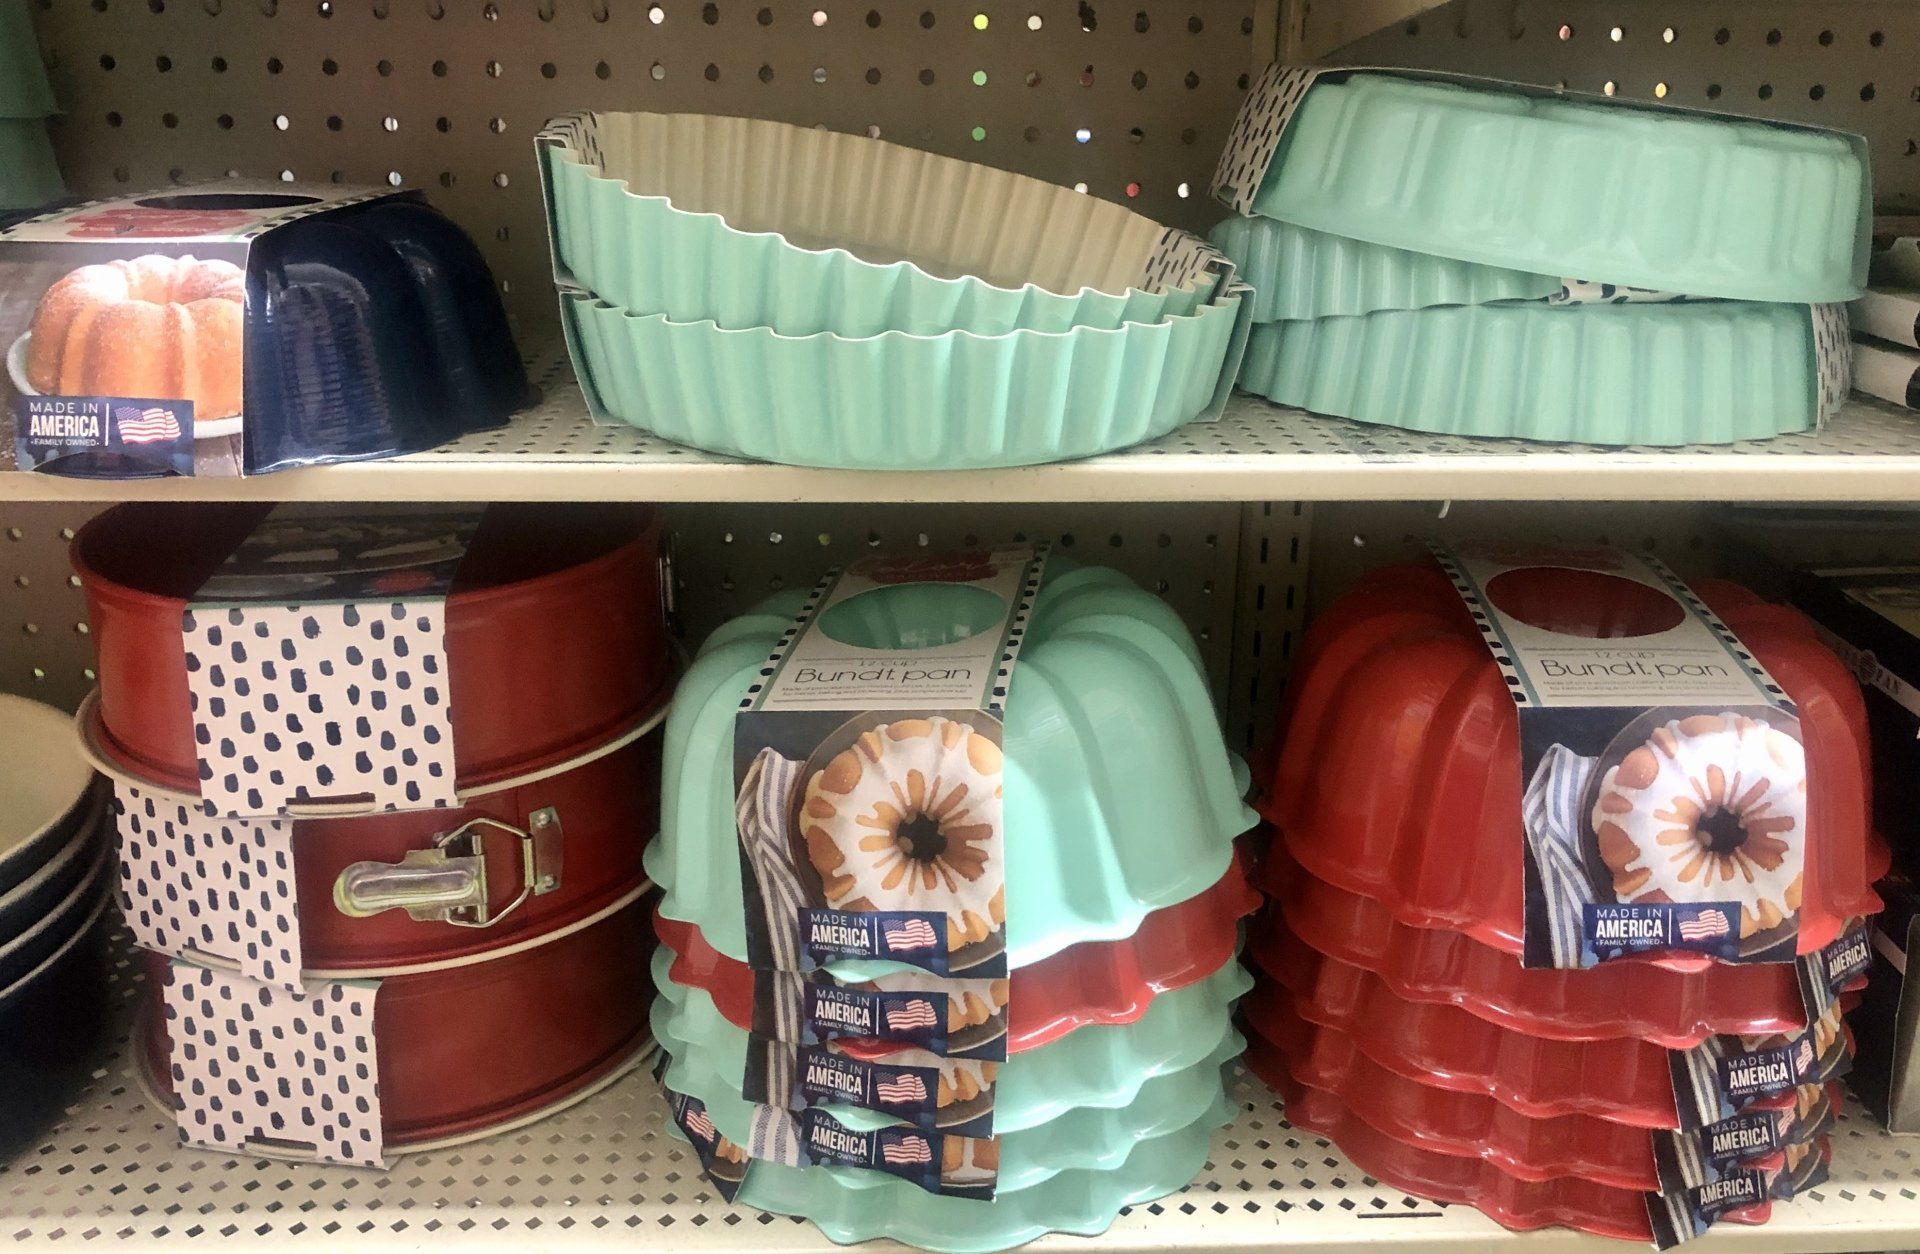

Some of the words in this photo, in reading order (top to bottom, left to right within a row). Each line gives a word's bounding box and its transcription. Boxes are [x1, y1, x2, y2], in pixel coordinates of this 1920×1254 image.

[30, 402, 75, 414] MADE
[83, 402, 98, 414] IN
[30, 415, 99, 437] AMERICA
[901, 668, 971, 683] pan
[1654, 662, 1729, 679] pan
[810, 913, 848, 926] MADE
[854, 917, 868, 927] IN
[1596, 908, 1639, 919] MADE
[1647, 908, 1662, 918] IN
[811, 924, 870, 948] AMERICA
[1596, 919, 1663, 938] AMERICA
[1827, 940, 1850, 960] MADE
[1853, 932, 1864, 943] IN
[1830, 942, 1868, 979] AMERICA
[816, 989, 851, 1004] MADE
[856, 996, 870, 1007] IN
[815, 1000, 871, 1027] AMERICA
[808, 1054, 844, 1071] MADE
[850, 1064, 862, 1075] IN
[1728, 1055, 1765, 1070] MADE
[1772, 1052, 1785, 1062] IN
[806, 1065, 862, 1095] AMERICA
[1730, 1062, 1789, 1089] AMERICA
[1711, 1119, 1747, 1134] MADE
[1754, 1116, 1767, 1126] IN
[811, 1125, 867, 1157] AMERICA
[1713, 1126, 1770, 1153] AMERICA
[1701, 1178, 1754, 1205] AMERICA
